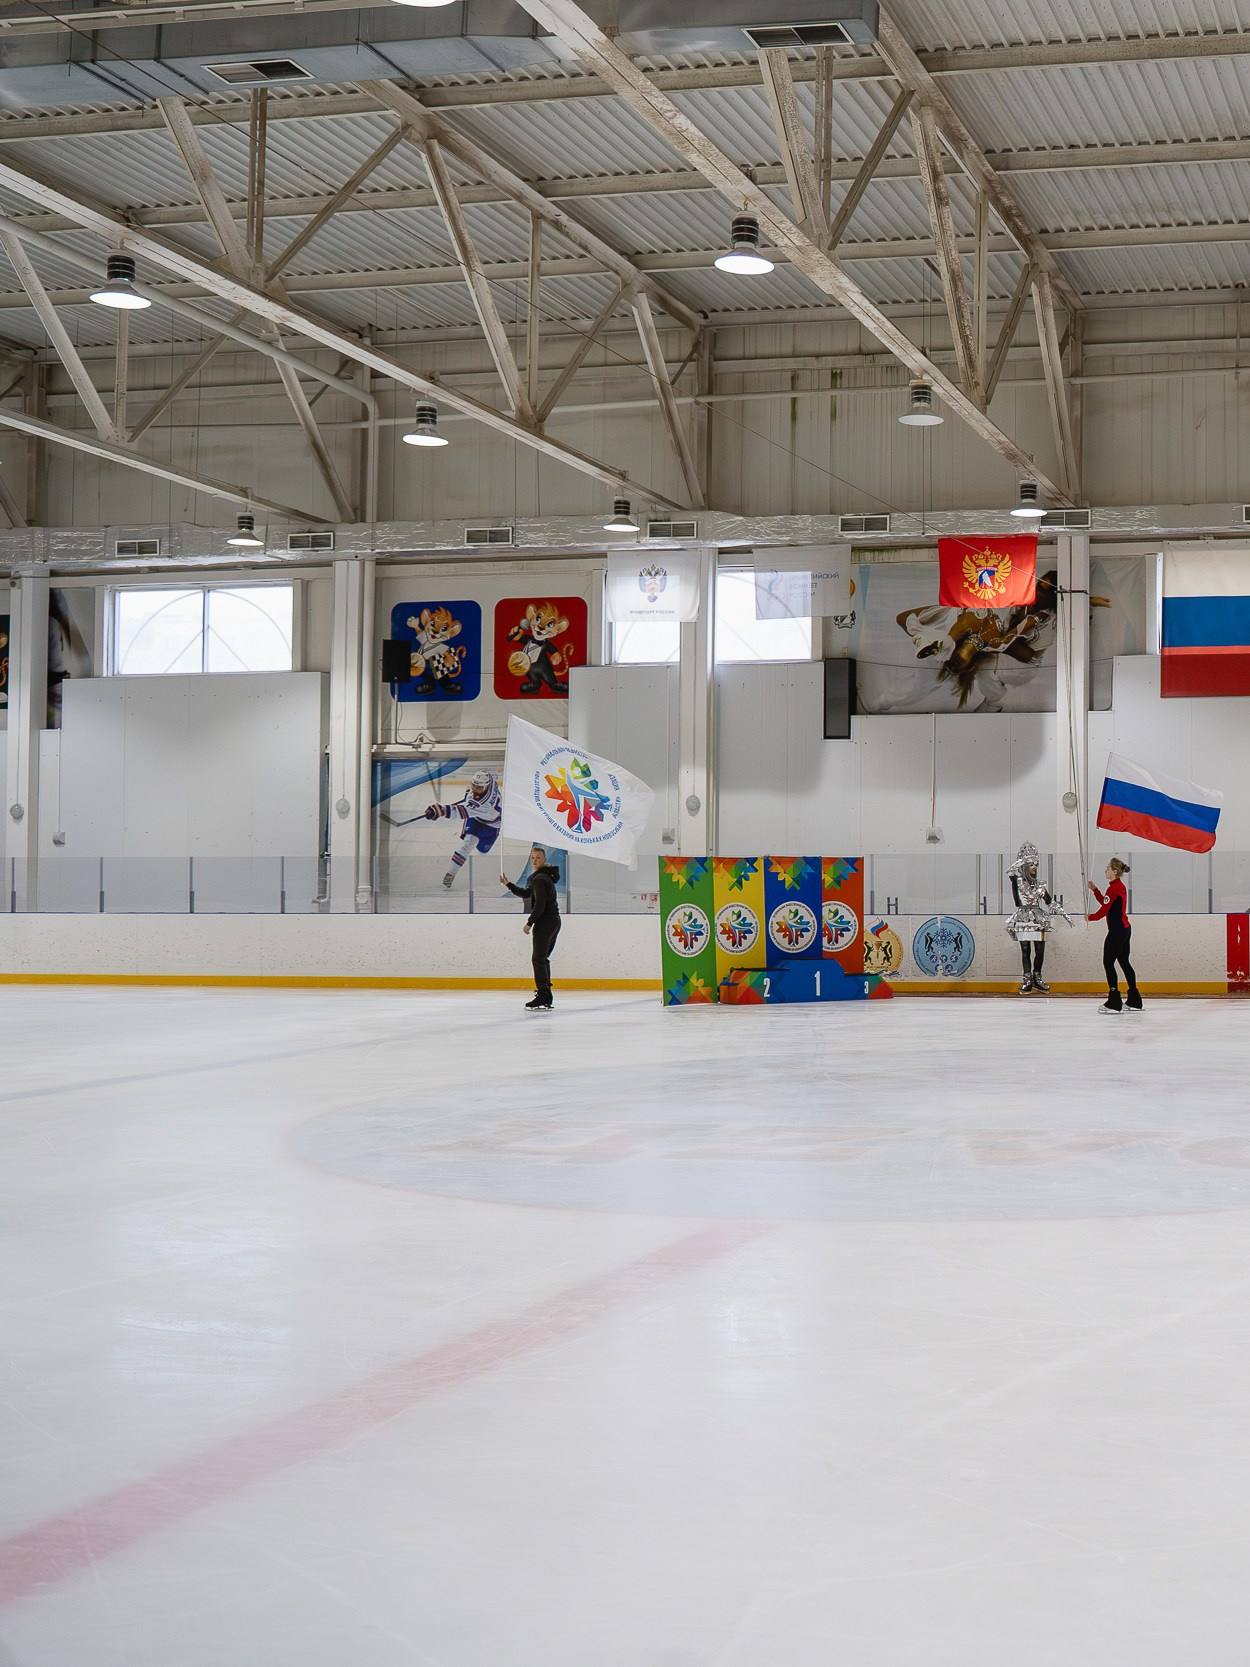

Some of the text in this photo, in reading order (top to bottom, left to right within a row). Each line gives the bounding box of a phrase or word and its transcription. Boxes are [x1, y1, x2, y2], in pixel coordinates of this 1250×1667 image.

[763, 977, 771, 998] 2
[814, 971, 821, 996] 1
[863, 981, 869, 994] 3
